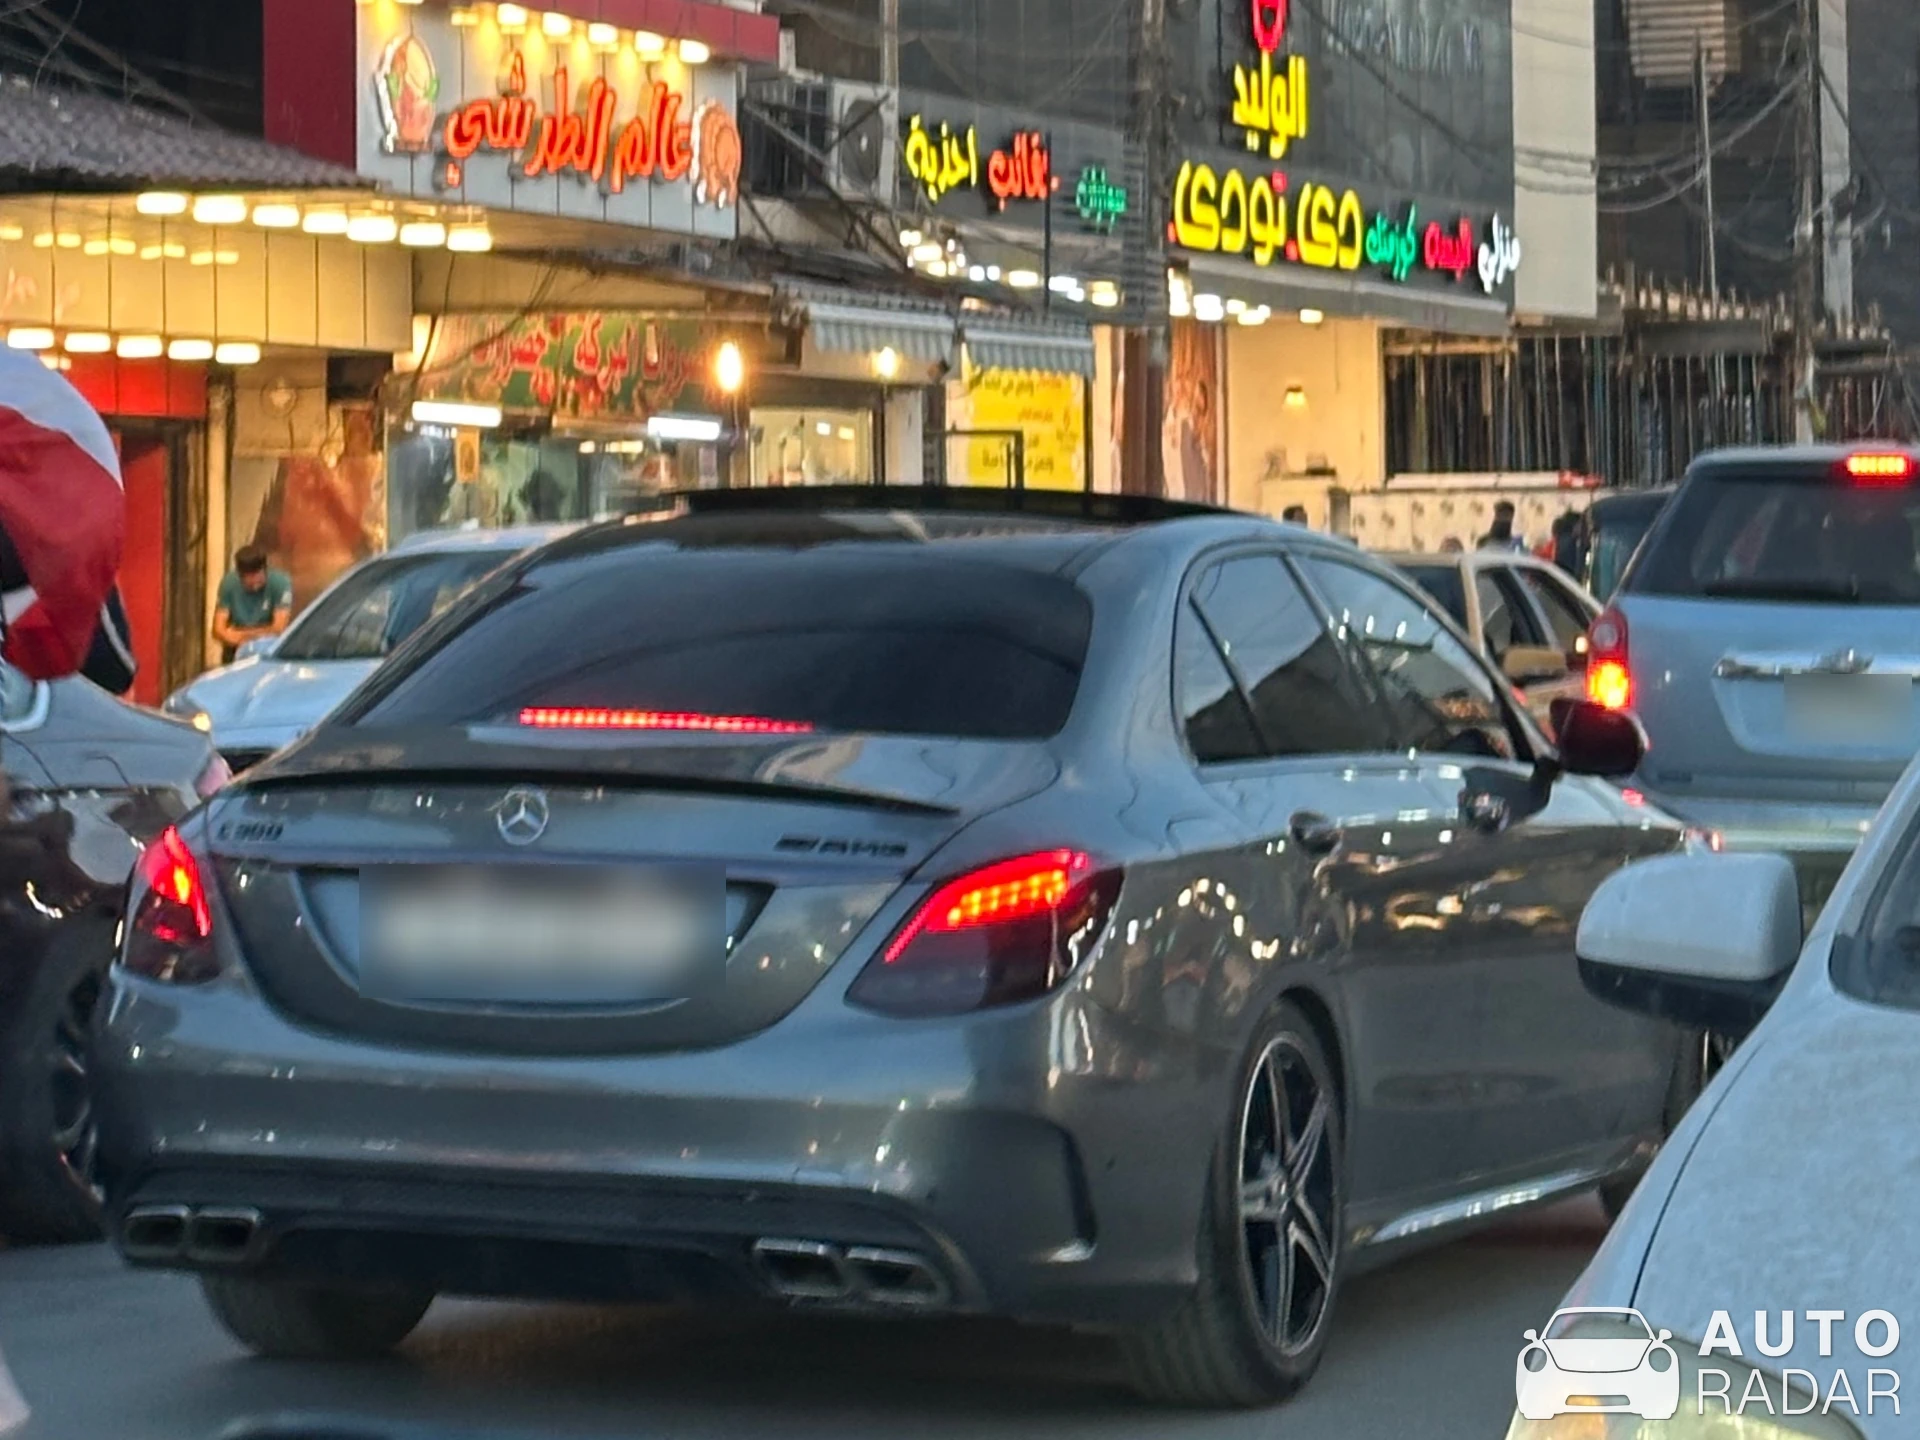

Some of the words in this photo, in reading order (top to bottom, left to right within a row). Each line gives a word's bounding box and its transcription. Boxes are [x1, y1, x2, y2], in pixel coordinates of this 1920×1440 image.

[445, 51, 616, 188] الطرشي
[614, 81, 691, 194] عالم
[1233, 51, 1306, 160] الوليد
